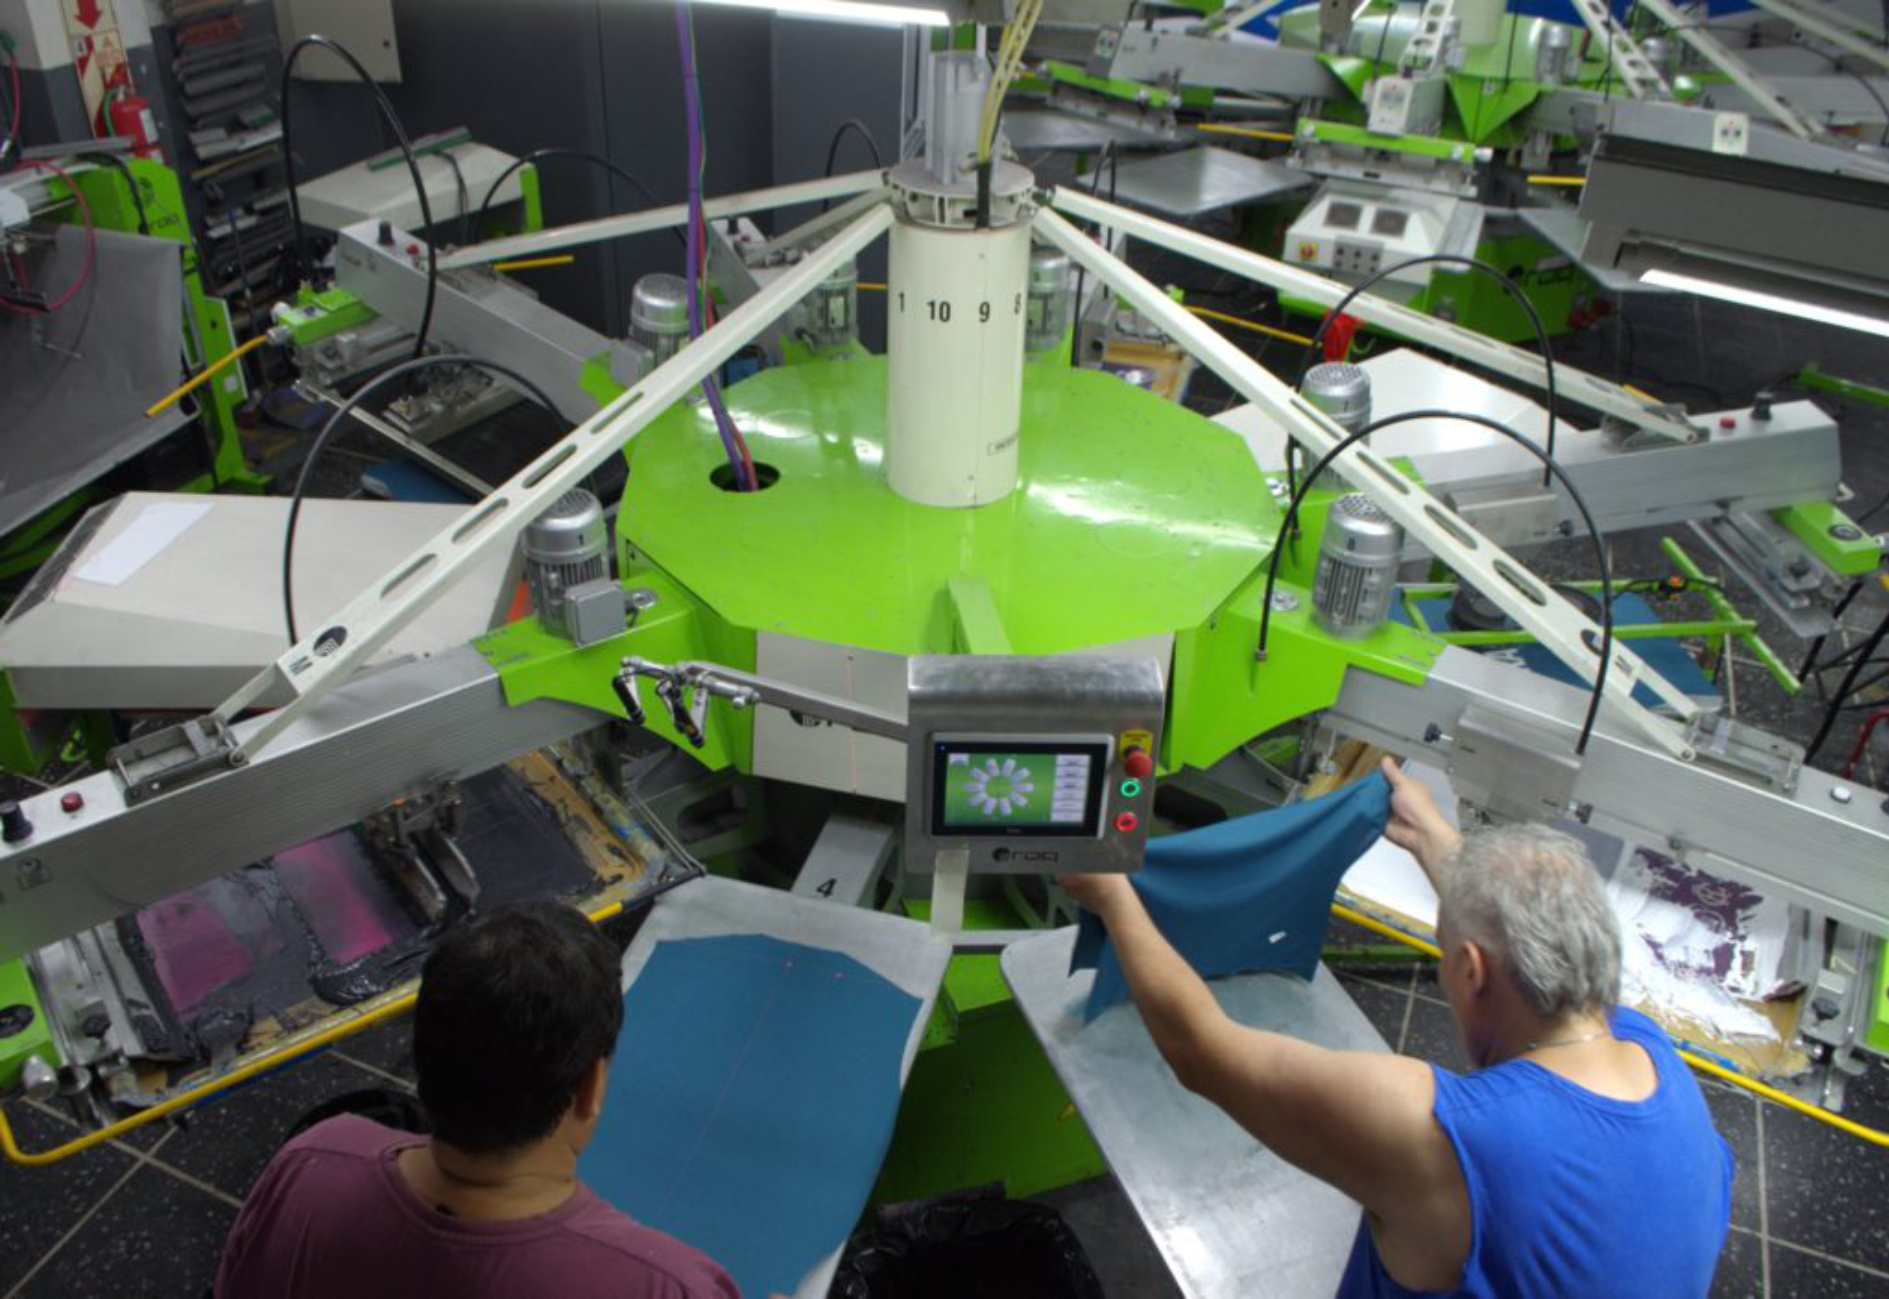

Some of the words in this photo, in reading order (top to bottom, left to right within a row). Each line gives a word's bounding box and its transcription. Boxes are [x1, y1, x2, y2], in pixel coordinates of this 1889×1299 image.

[899, 292, 905, 313] 1
[927, 300, 951, 323] 10
[979, 301, 991, 323] 9
[1011, 851, 1059, 866] roq
[816, 878, 836, 898] 4
